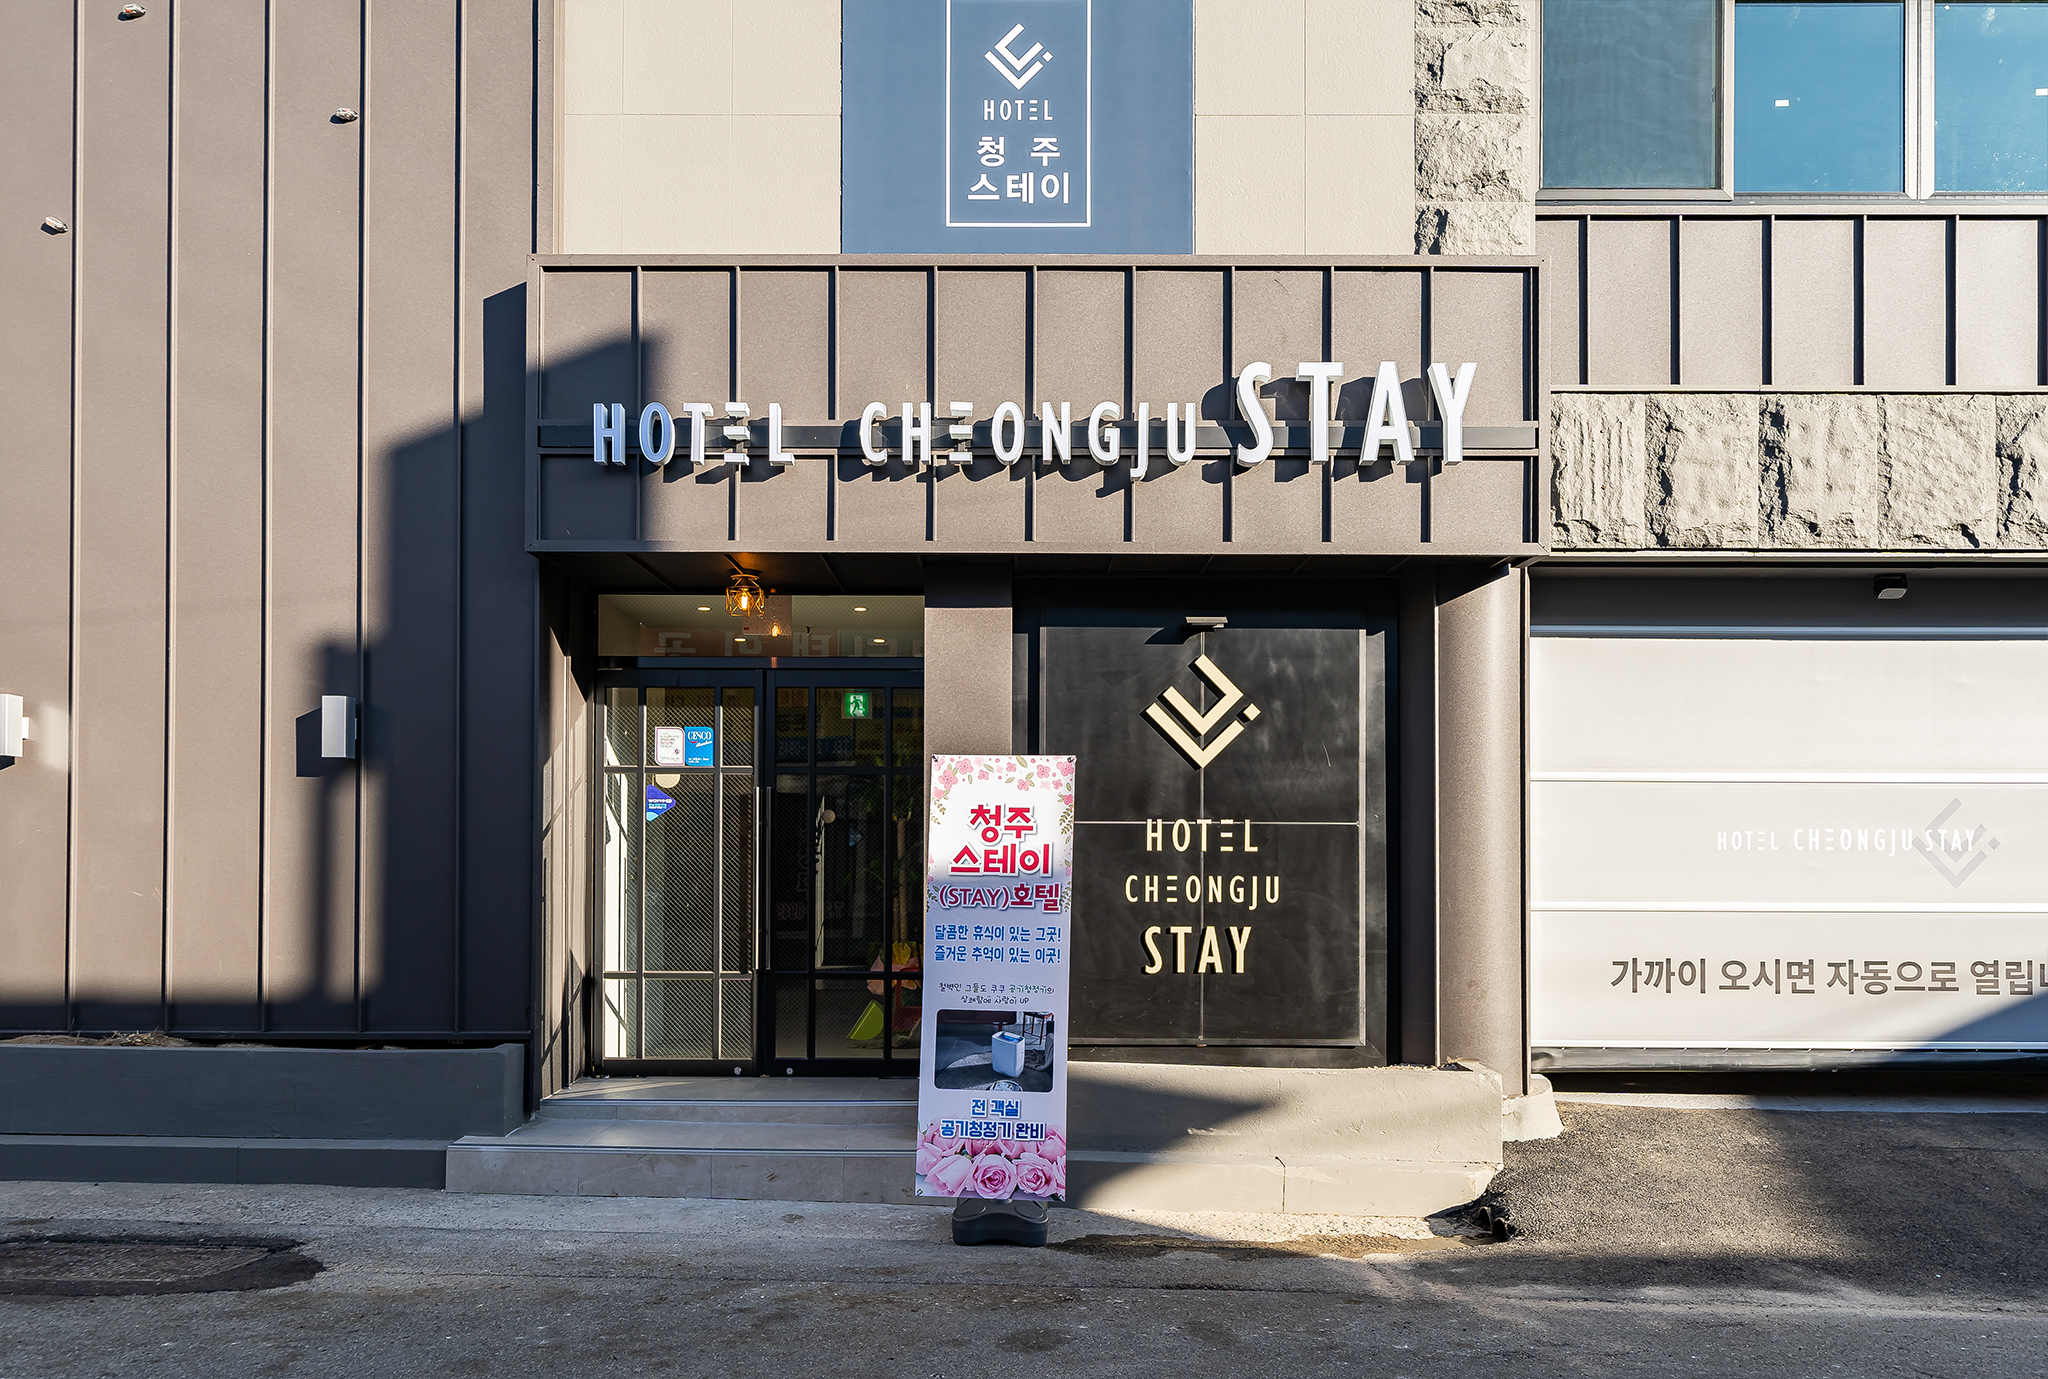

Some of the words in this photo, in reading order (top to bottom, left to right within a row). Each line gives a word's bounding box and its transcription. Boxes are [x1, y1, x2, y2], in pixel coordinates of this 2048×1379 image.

[983, 99, 1054, 121] HOTEL
[967, 171, 1070, 204] 스테이
[593, 402, 795, 466] HOTEL
[860, 401, 1196, 481] CHEONGJU
[1236, 361, 1477, 466] STAY
[687, 731, 712, 740] CESCO
[969, 804, 1034, 843] 청주
[1146, 818, 1258, 852] HOTEL
[1717, 830, 1779, 851] HOTEL
[1793, 828, 1914, 857] CHEONGJU
[1925, 829, 1976, 852] STAY
[950, 843, 1051, 874] 스테이
[1125, 875, 1280, 910] CHEONGJU
[935, 924, 968, 941] 달콤한
[973, 925, 1004, 941] 휴식이
[1009, 926, 1031, 942] 있는
[1035, 926, 1061, 942] 그곳!
[934, 945, 967, 962] 즐거운
[971, 946, 1004, 962] 추억이
[1009, 946, 1031, 963] 있는
[1035, 947, 1061, 963] 이곳!
[1144, 926, 1251, 974] STAY
[991, 984, 1006, 993] 쿠쿠
[1610, 958, 1706, 995] 가까이
[1719, 958, 1816, 995] 오시면
[1827, 958, 1960, 995] 자동으로
[971, 1099, 986, 1116] 전
[990, 1099, 1021, 1117] 객실
[940, 1120, 1011, 1138] 공기청정기
[1015, 1122, 1046, 1140] 완비
